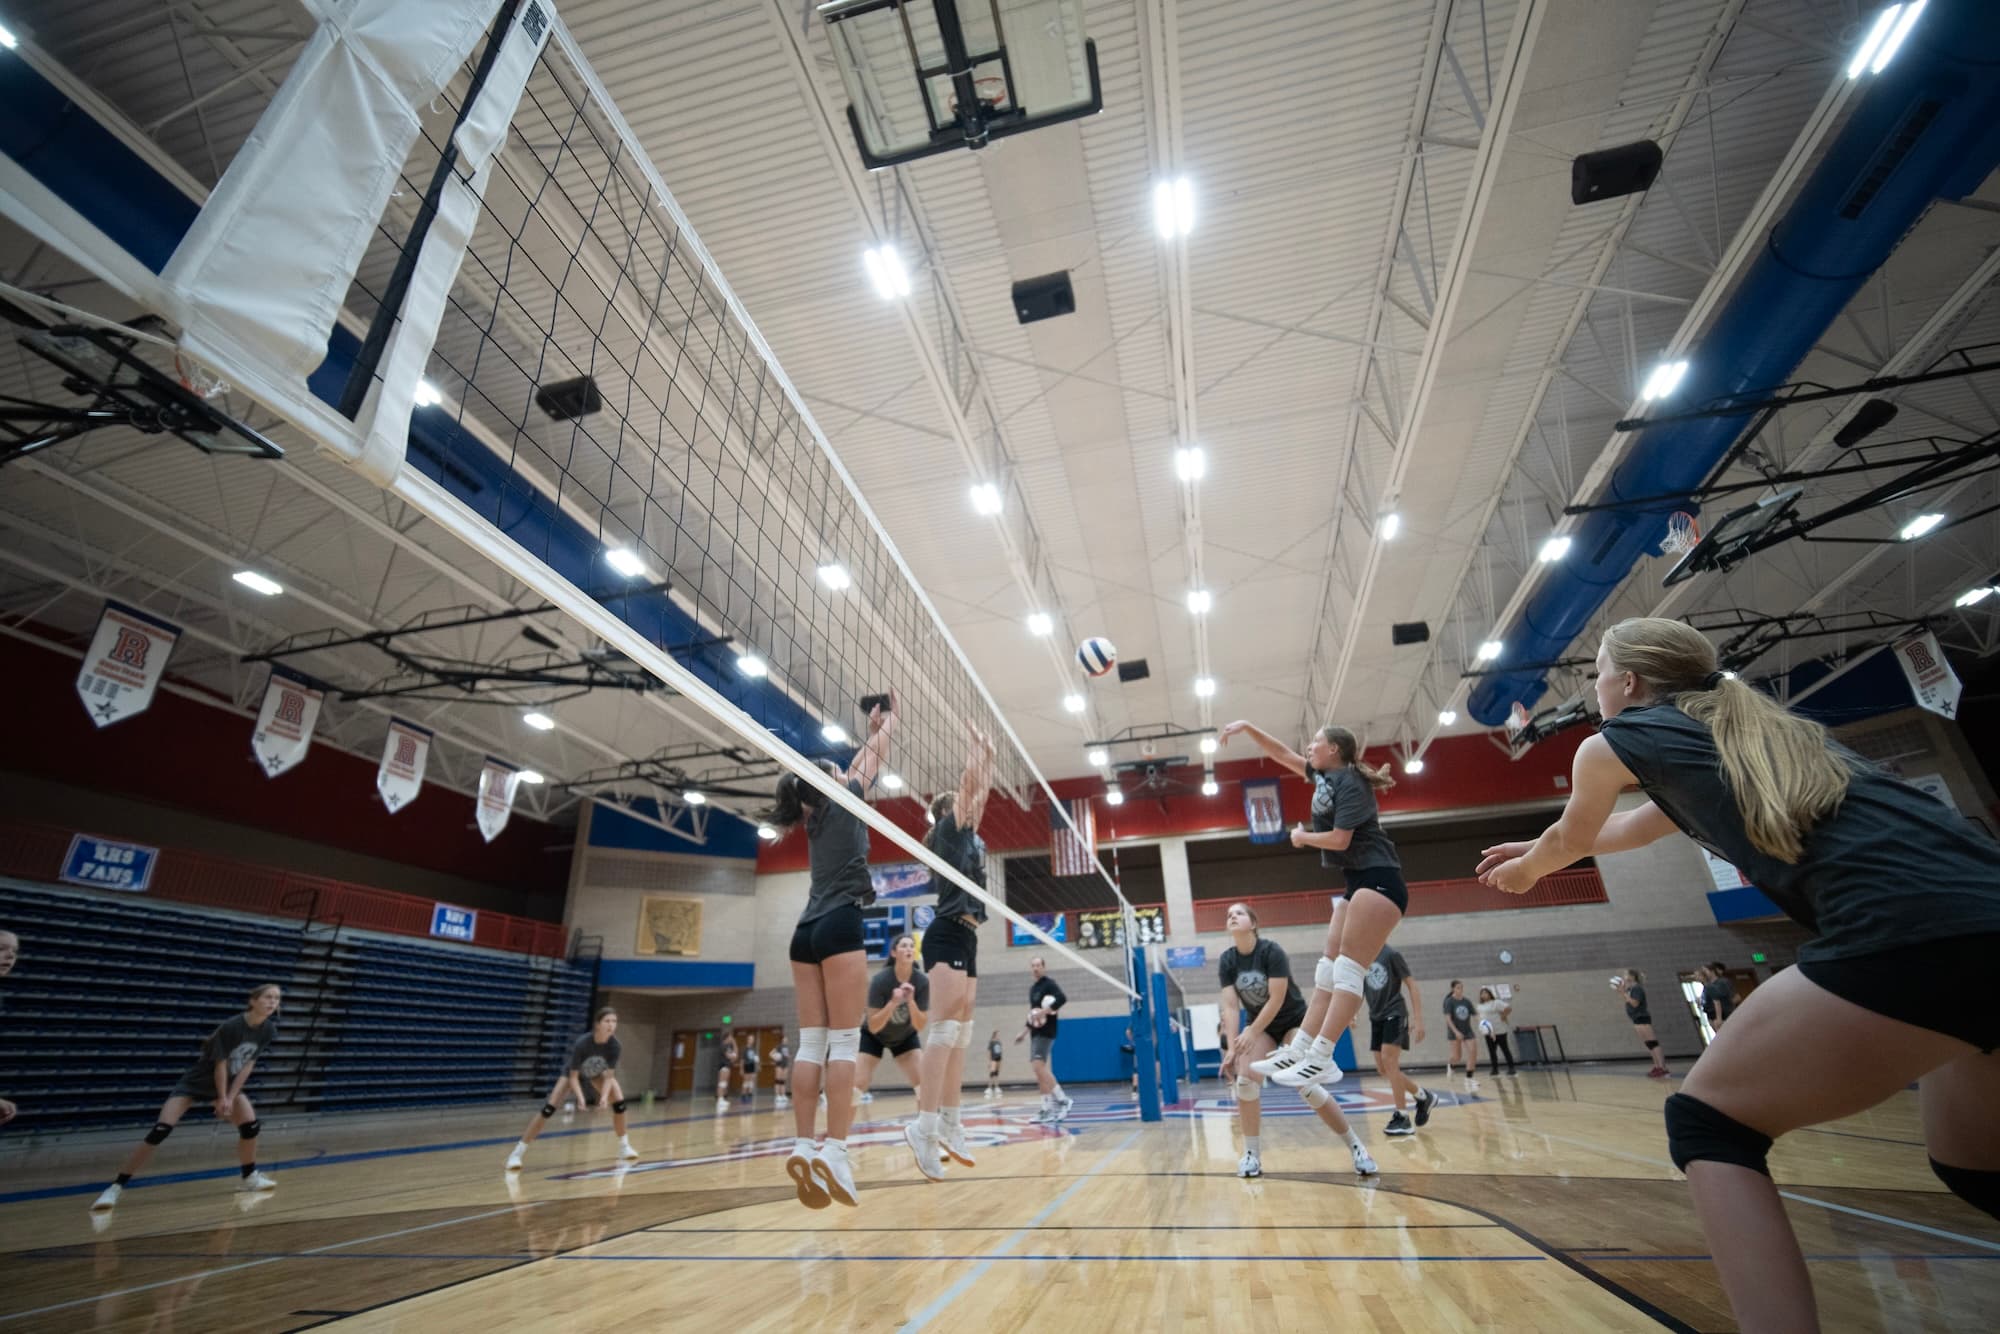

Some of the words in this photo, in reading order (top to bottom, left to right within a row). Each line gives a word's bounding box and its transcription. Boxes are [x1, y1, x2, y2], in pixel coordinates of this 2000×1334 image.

[108, 626, 151, 670] R
[1905, 641, 1936, 674] R
[274, 689, 305, 725] R
[93, 843, 135, 865] RHS
[78, 861, 134, 884] FANS
